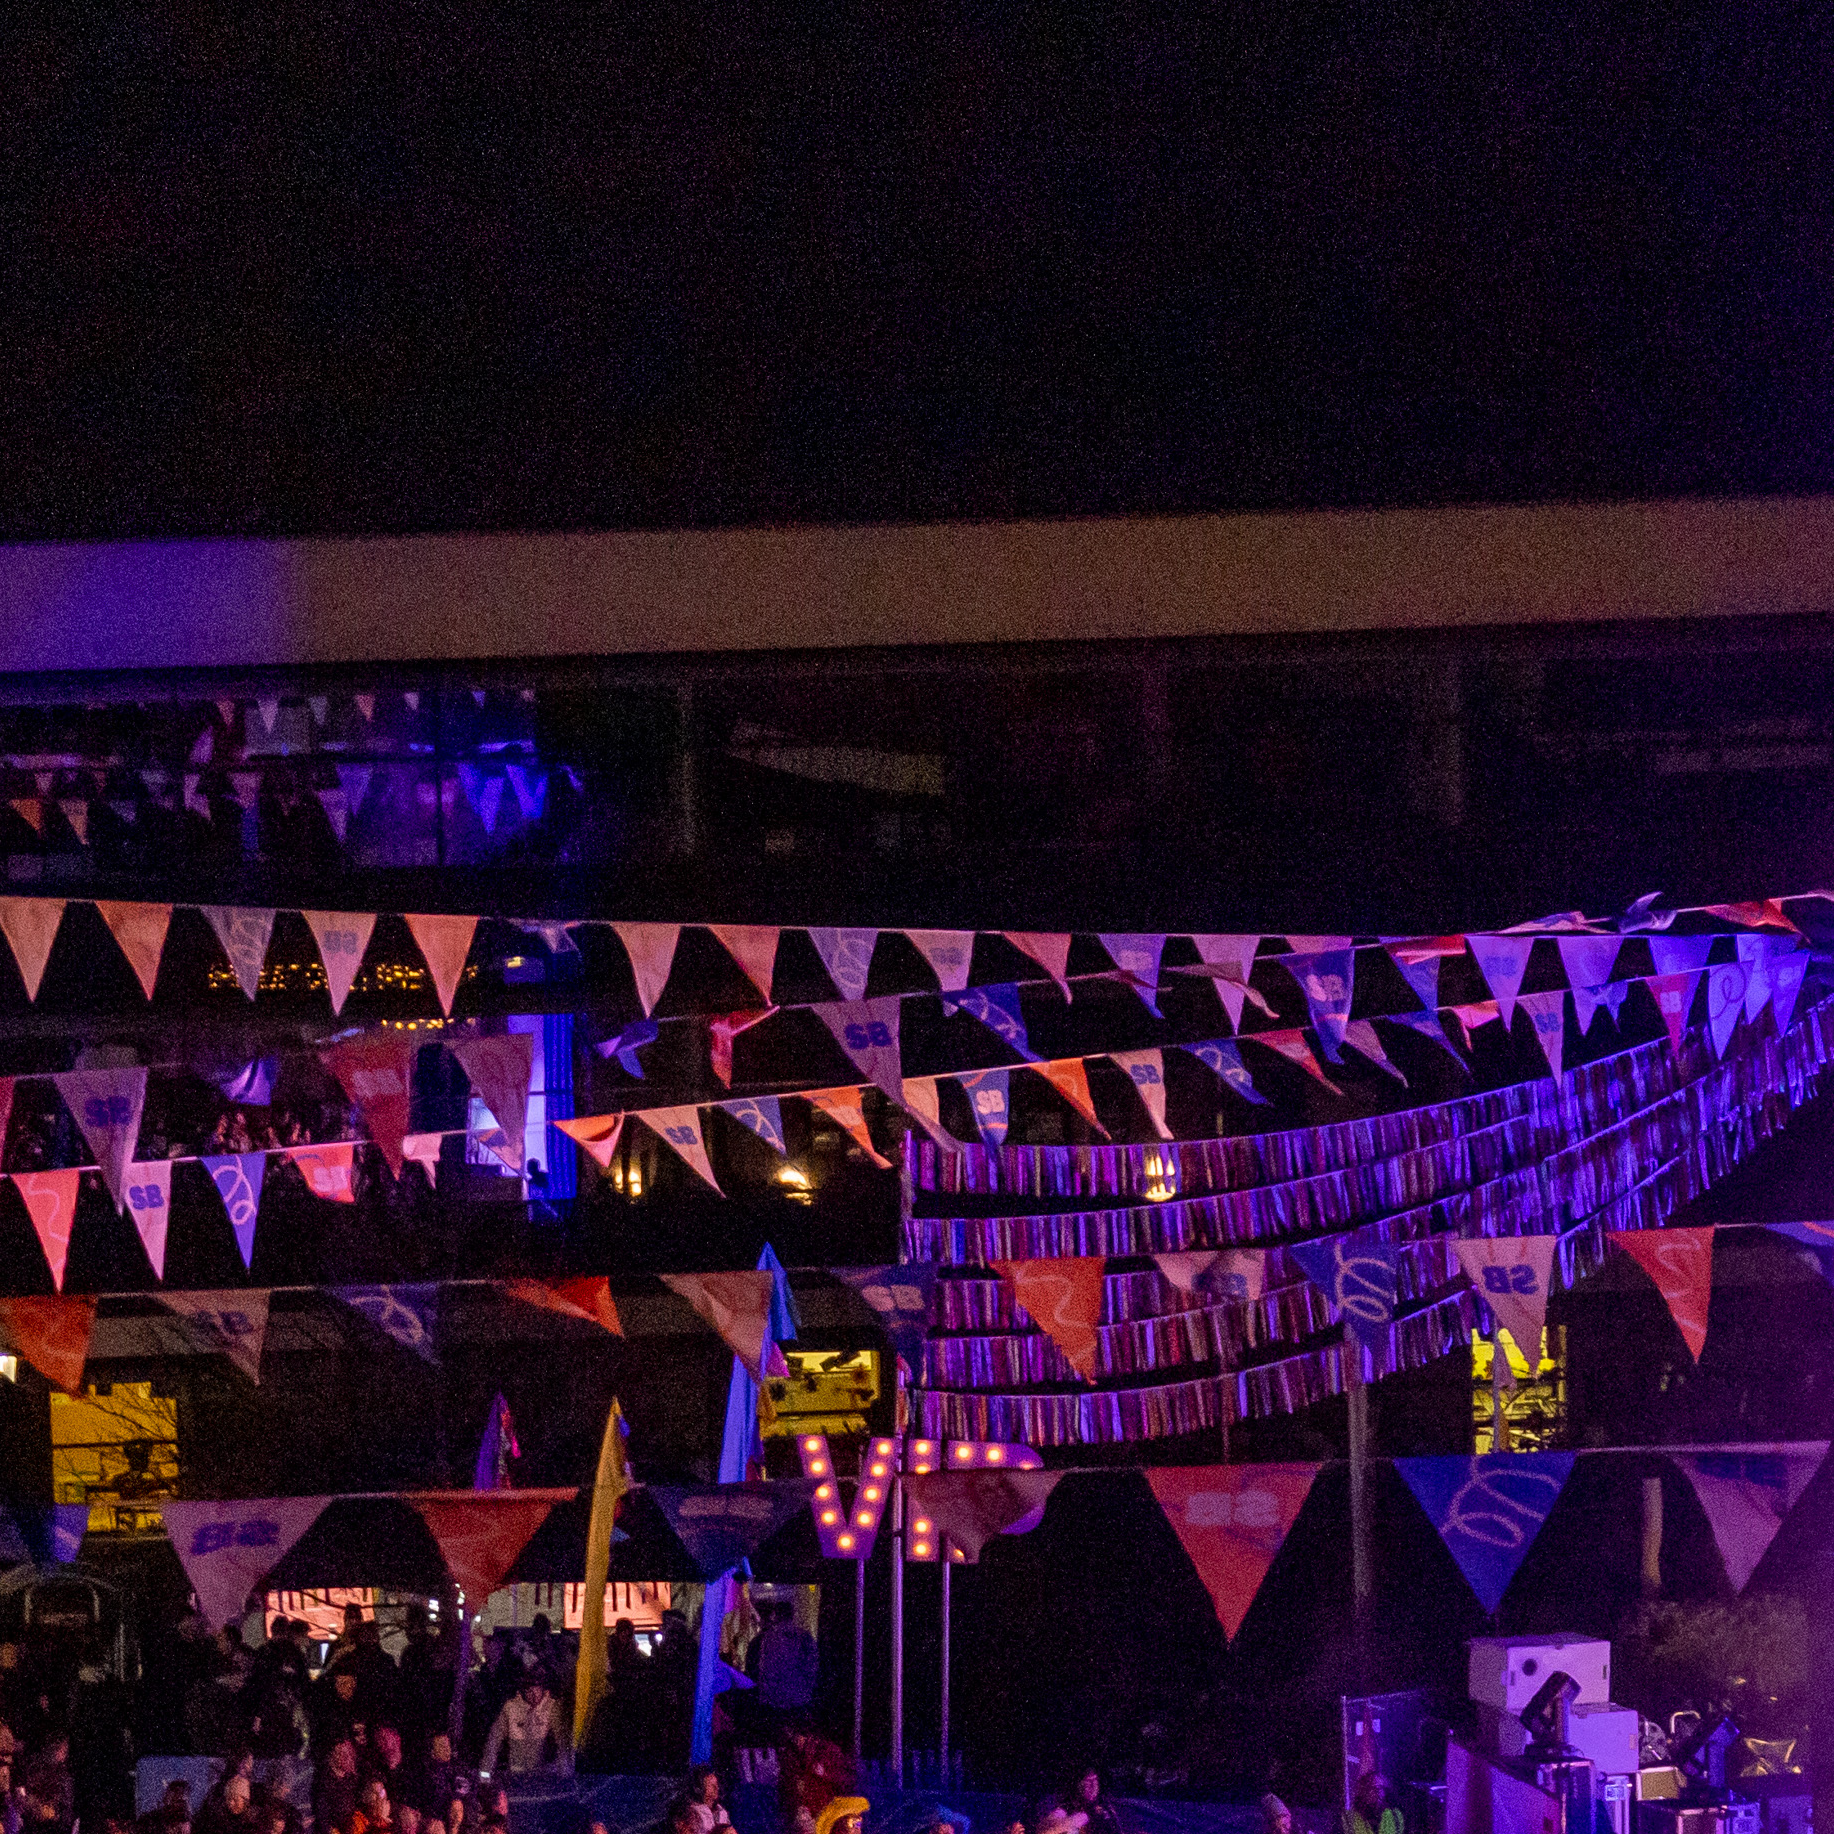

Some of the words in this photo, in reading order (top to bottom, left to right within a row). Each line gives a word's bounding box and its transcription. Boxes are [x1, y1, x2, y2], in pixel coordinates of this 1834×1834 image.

[845, 1022, 892, 1048] SB
[1130, 1063, 1160, 1085] SB
[975, 1089, 1005, 1114] SB
[129, 1184, 163, 1210] SB
